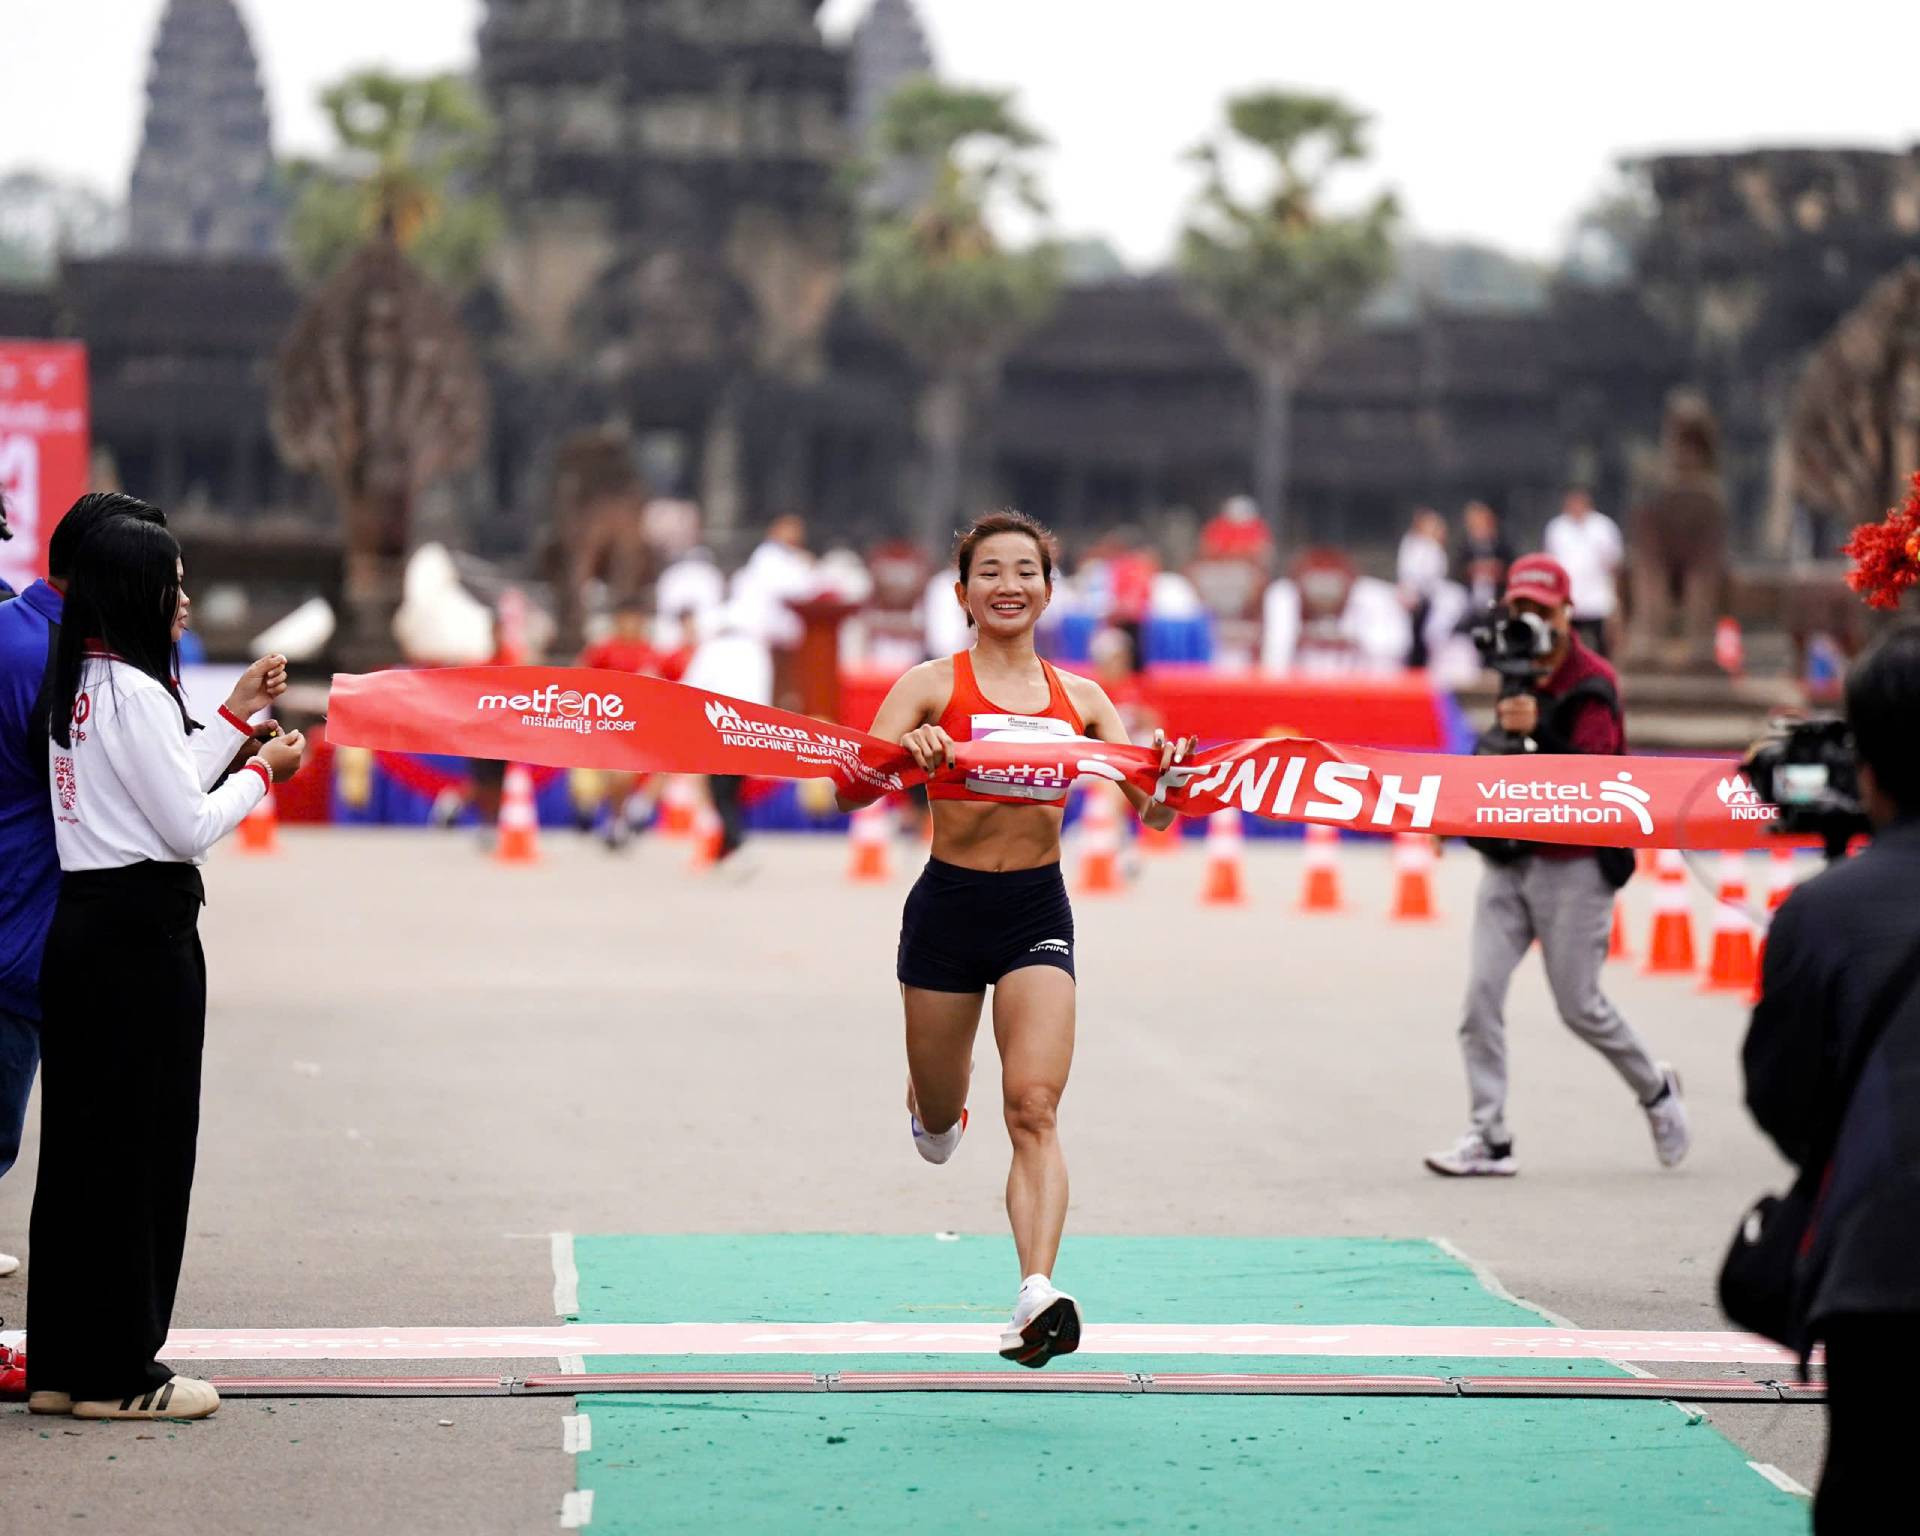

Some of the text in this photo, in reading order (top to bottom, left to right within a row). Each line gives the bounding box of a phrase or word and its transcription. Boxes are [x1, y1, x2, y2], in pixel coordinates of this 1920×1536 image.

[478, 684, 624, 717] metfone
[597, 717, 637, 731] closer
[719, 715, 862, 755] ANGKOR WAT
[722, 734, 795, 752] INDOCHINE
[796, 754, 832, 765] Powered
[1477, 778, 1592, 800] viettel
[1476, 803, 1622, 824] marathon
